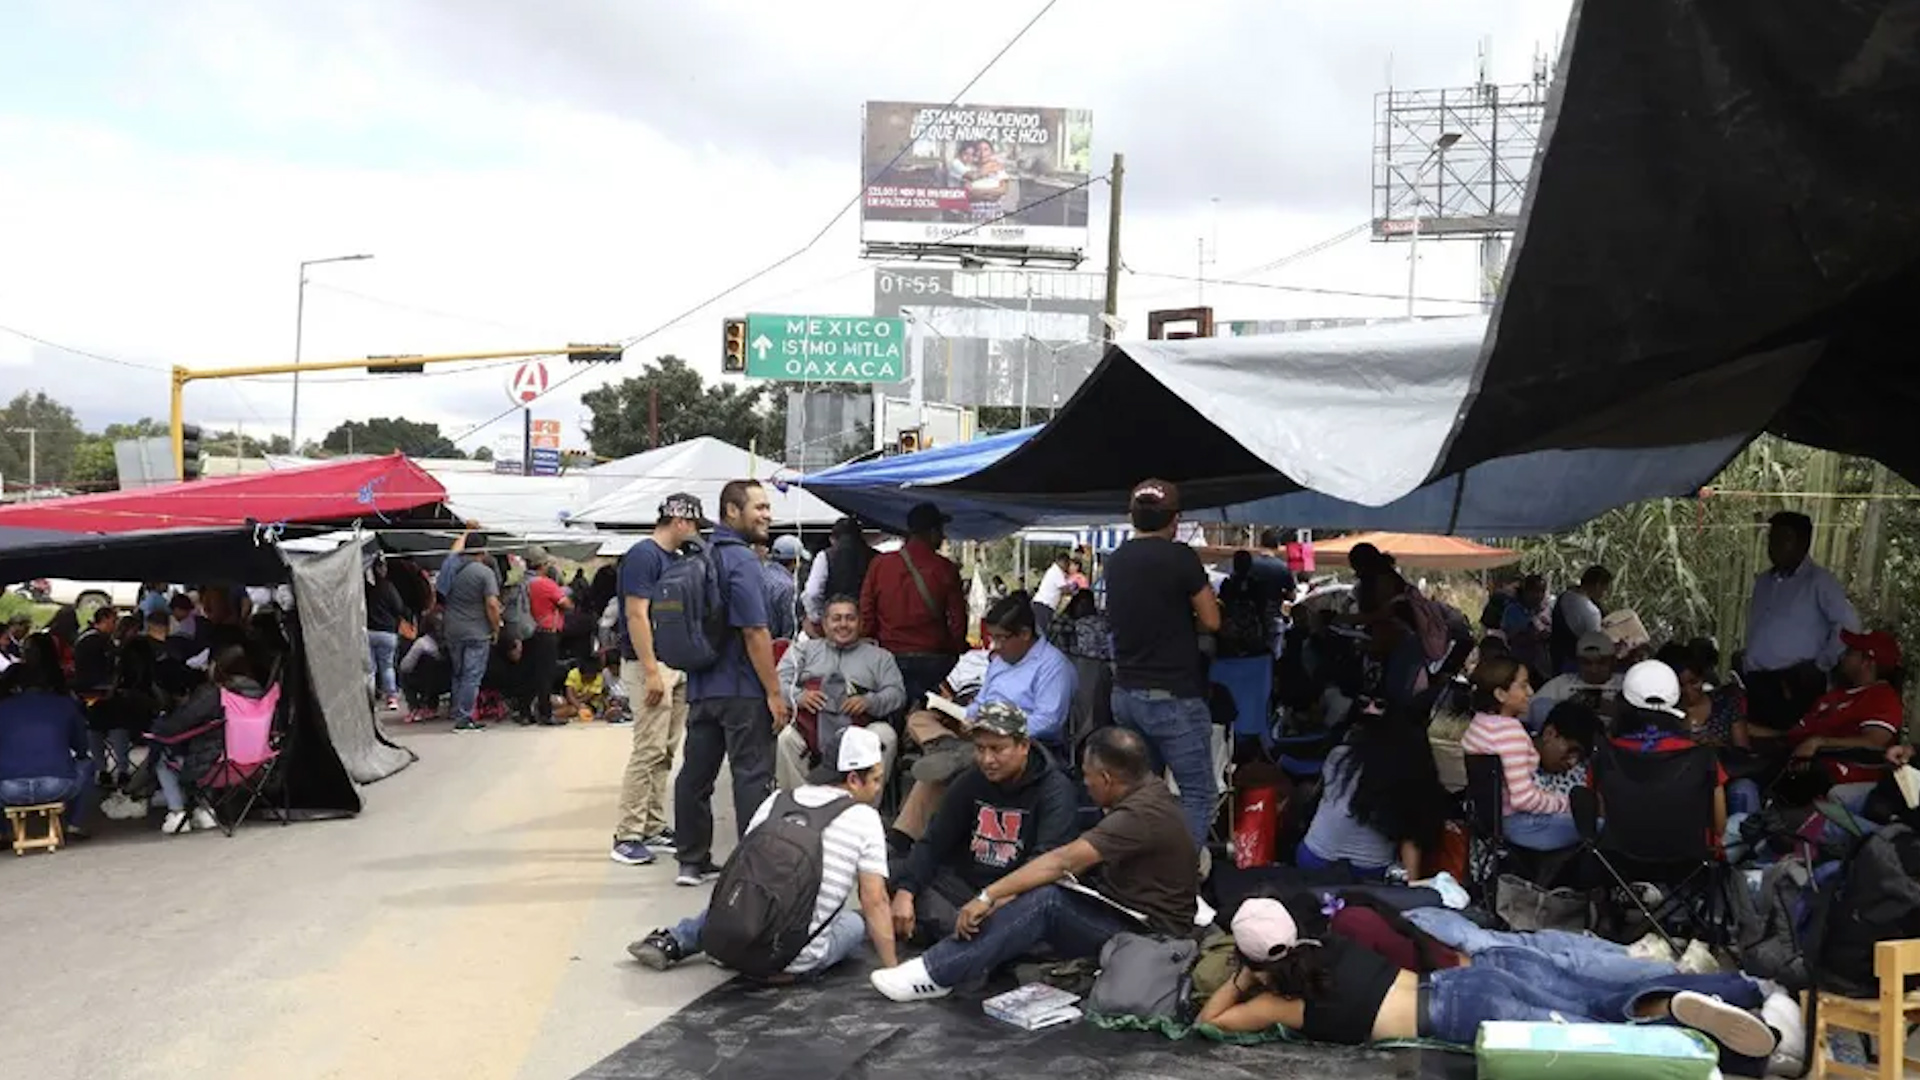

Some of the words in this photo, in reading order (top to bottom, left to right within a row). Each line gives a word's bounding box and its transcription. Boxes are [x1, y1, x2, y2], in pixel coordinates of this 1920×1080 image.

[919, 109, 976, 127] ESTAMOS
[977, 110, 1040, 129] HACIENDO
[927, 124, 954, 140] QUE
[955, 126, 999, 142] NUNCA
[1001, 127, 1016, 143] SE
[1018, 128, 1049, 144] HIZO
[787, 320, 890, 337] MEXICO
[782, 339, 837, 356] ISTMO
[843, 341, 899, 357] MITLA
[785, 359, 895, 377] OAXACA
